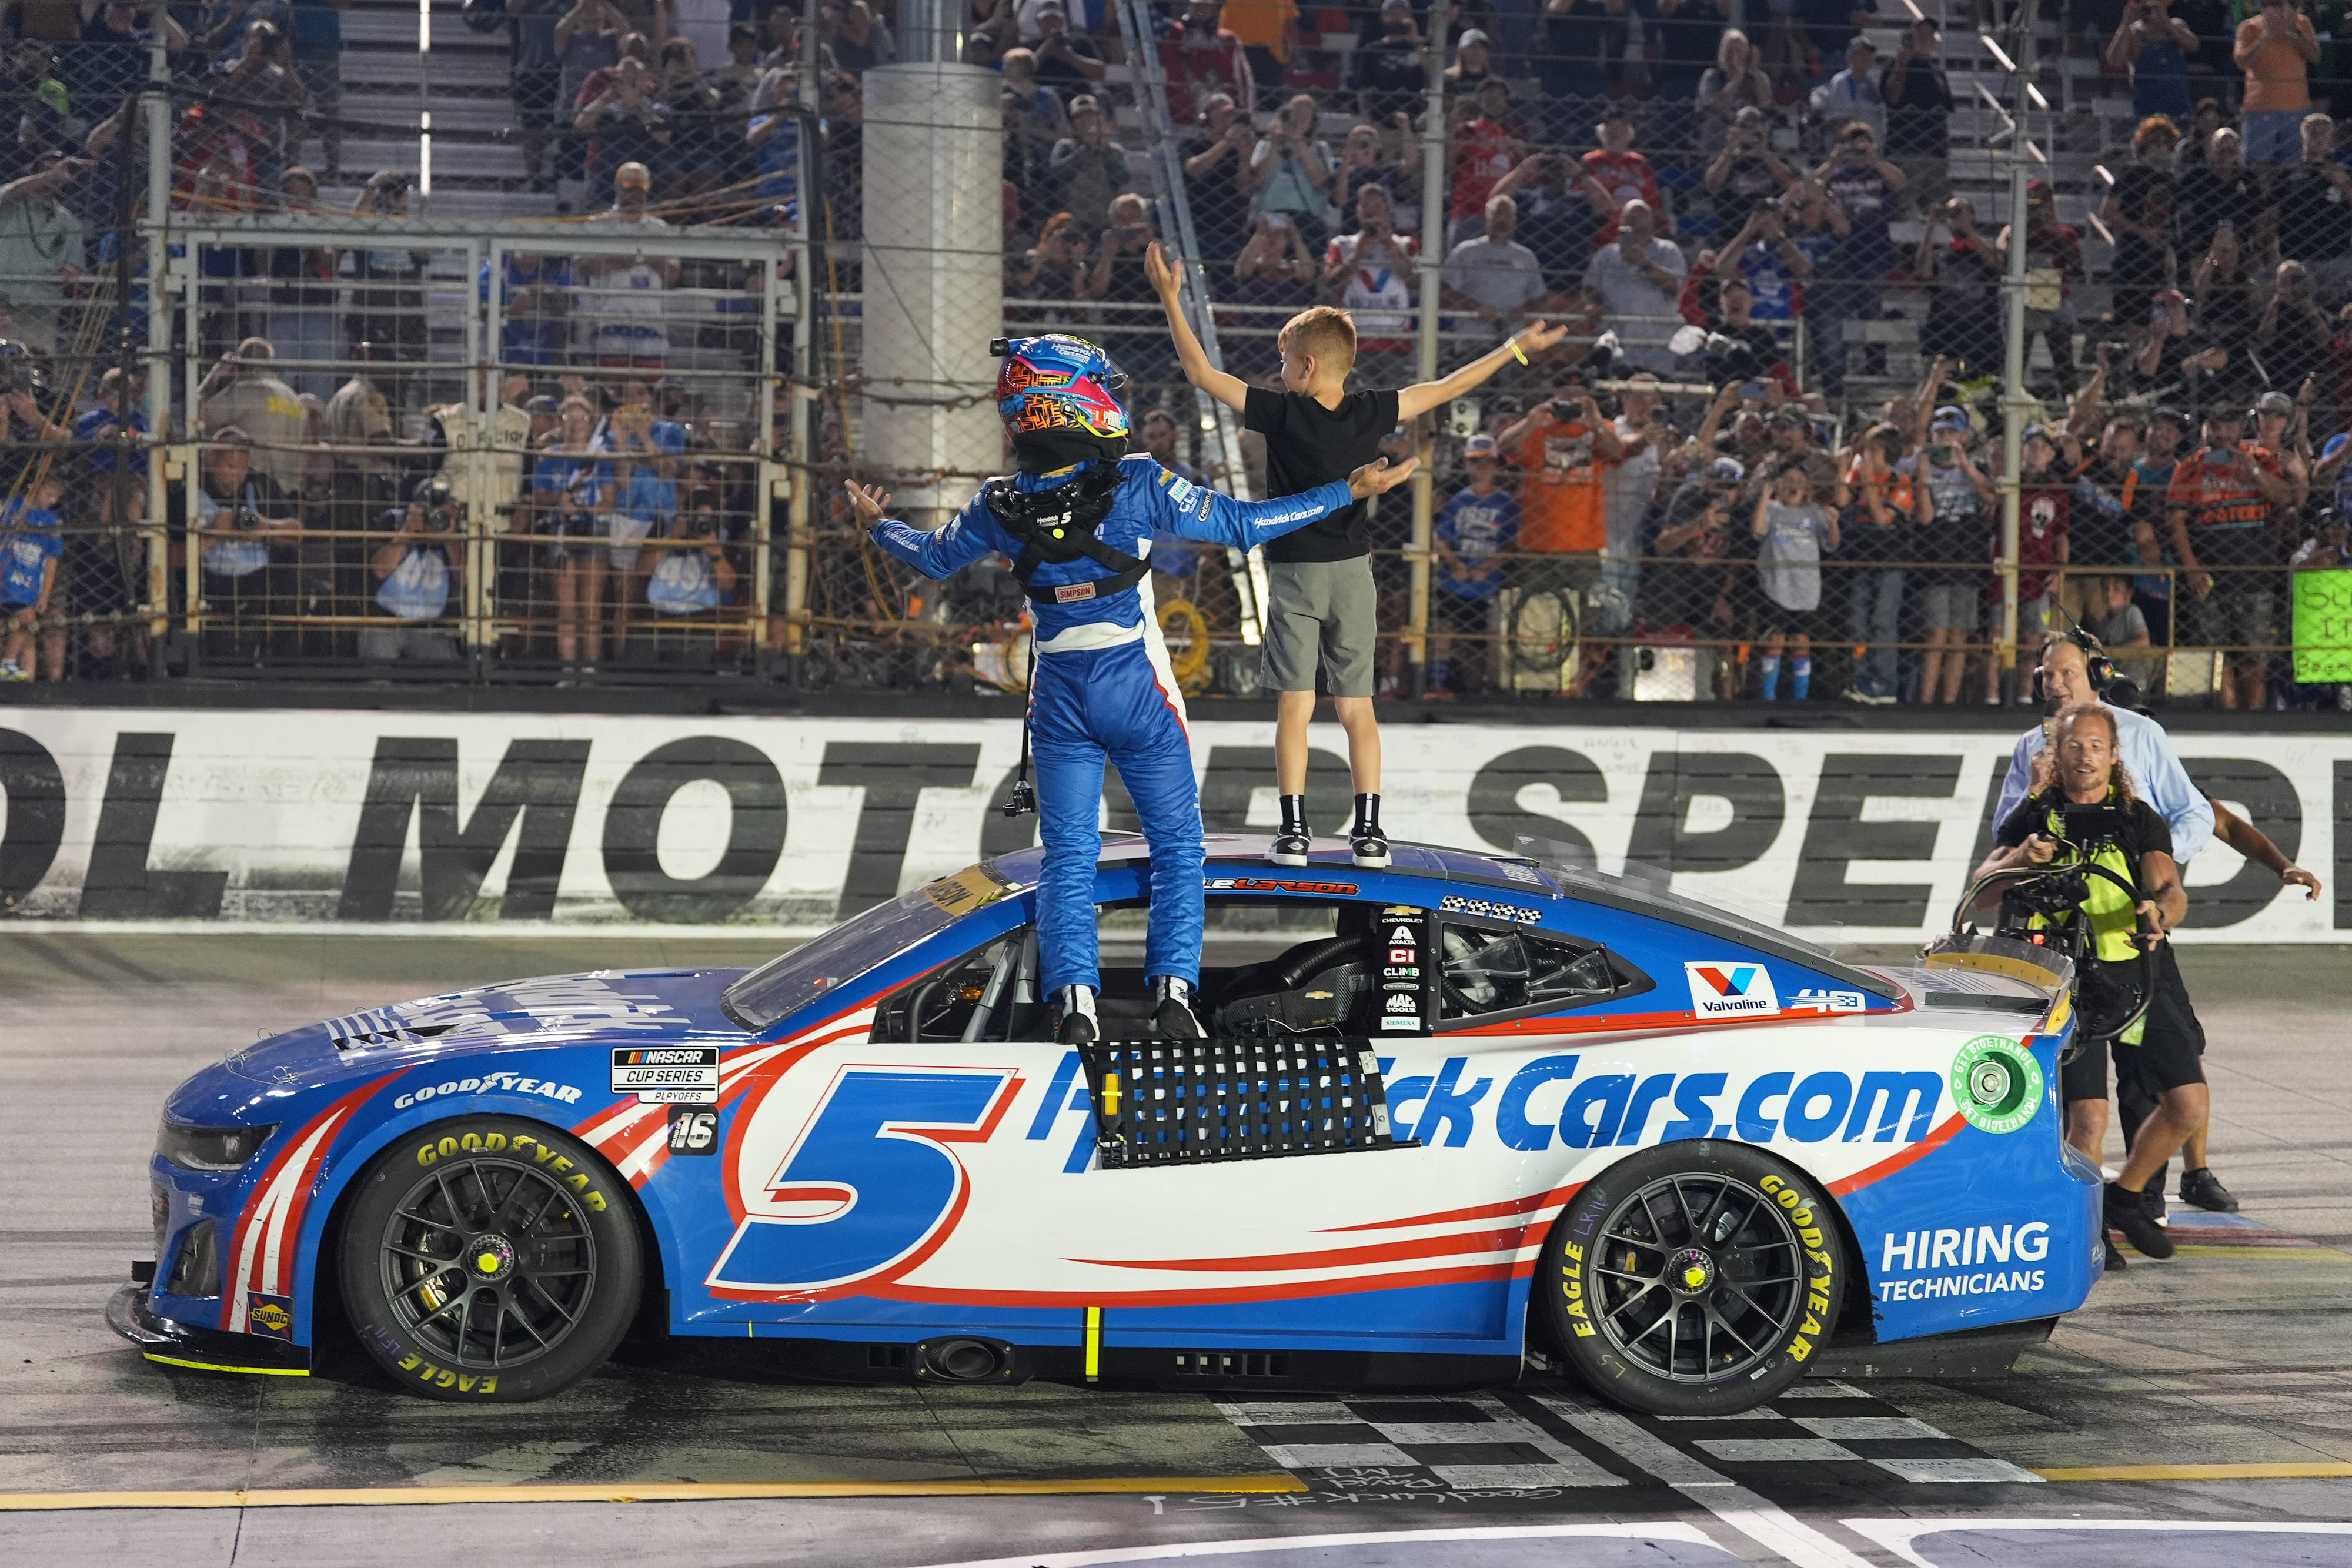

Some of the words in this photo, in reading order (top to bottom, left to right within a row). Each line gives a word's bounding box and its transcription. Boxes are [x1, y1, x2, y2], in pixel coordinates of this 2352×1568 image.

[1051, 343, 1092, 356] Hendrick
[1058, 349, 1090, 362] Cars.com
[1103, 410, 1122, 430] PRIME
[1037, 514, 1059, 525] Hendrick
[1061, 511, 1072, 524] 5
[1254, 505, 1324, 529] HendrickCars.com
[1060, 587, 1091, 599] SIMPSON
[337, 735, 1353, 924] MOTR
[1390, 949, 1415, 963] CI
[1383, 967, 1421, 977] CLIMB
[1385, 994, 1416, 1008] MAC
[1702, 998, 1767, 1012] Valvoline
[645, 1051, 704, 1064] NASCAR
[1953, 1052, 1970, 1074] GET
[1966, 1037, 2034, 1069] BIOETHANOL
[627, 1071, 654, 1082] CUP
[656, 1070, 703, 1082] SERIES
[393, 1071, 582, 1109] GOODYEAR
[670, 1127, 681, 1148] ROUND
[675, 1112, 717, 1148] 16
[417, 1132, 608, 1215] GOODYEAR
[703, 1064, 1024, 1293] 5
[1881, 1221, 2050, 1273] HIRING
[1759, 1174, 1833, 1363] GOODYEAR
[1563, 1240, 1596, 1339] EAGLE
[1879, 1270, 2046, 1302] TECHNICIANS
[397, 1351, 500, 1393] EAGLE
[1447, 1489, 1563, 1503] Good
